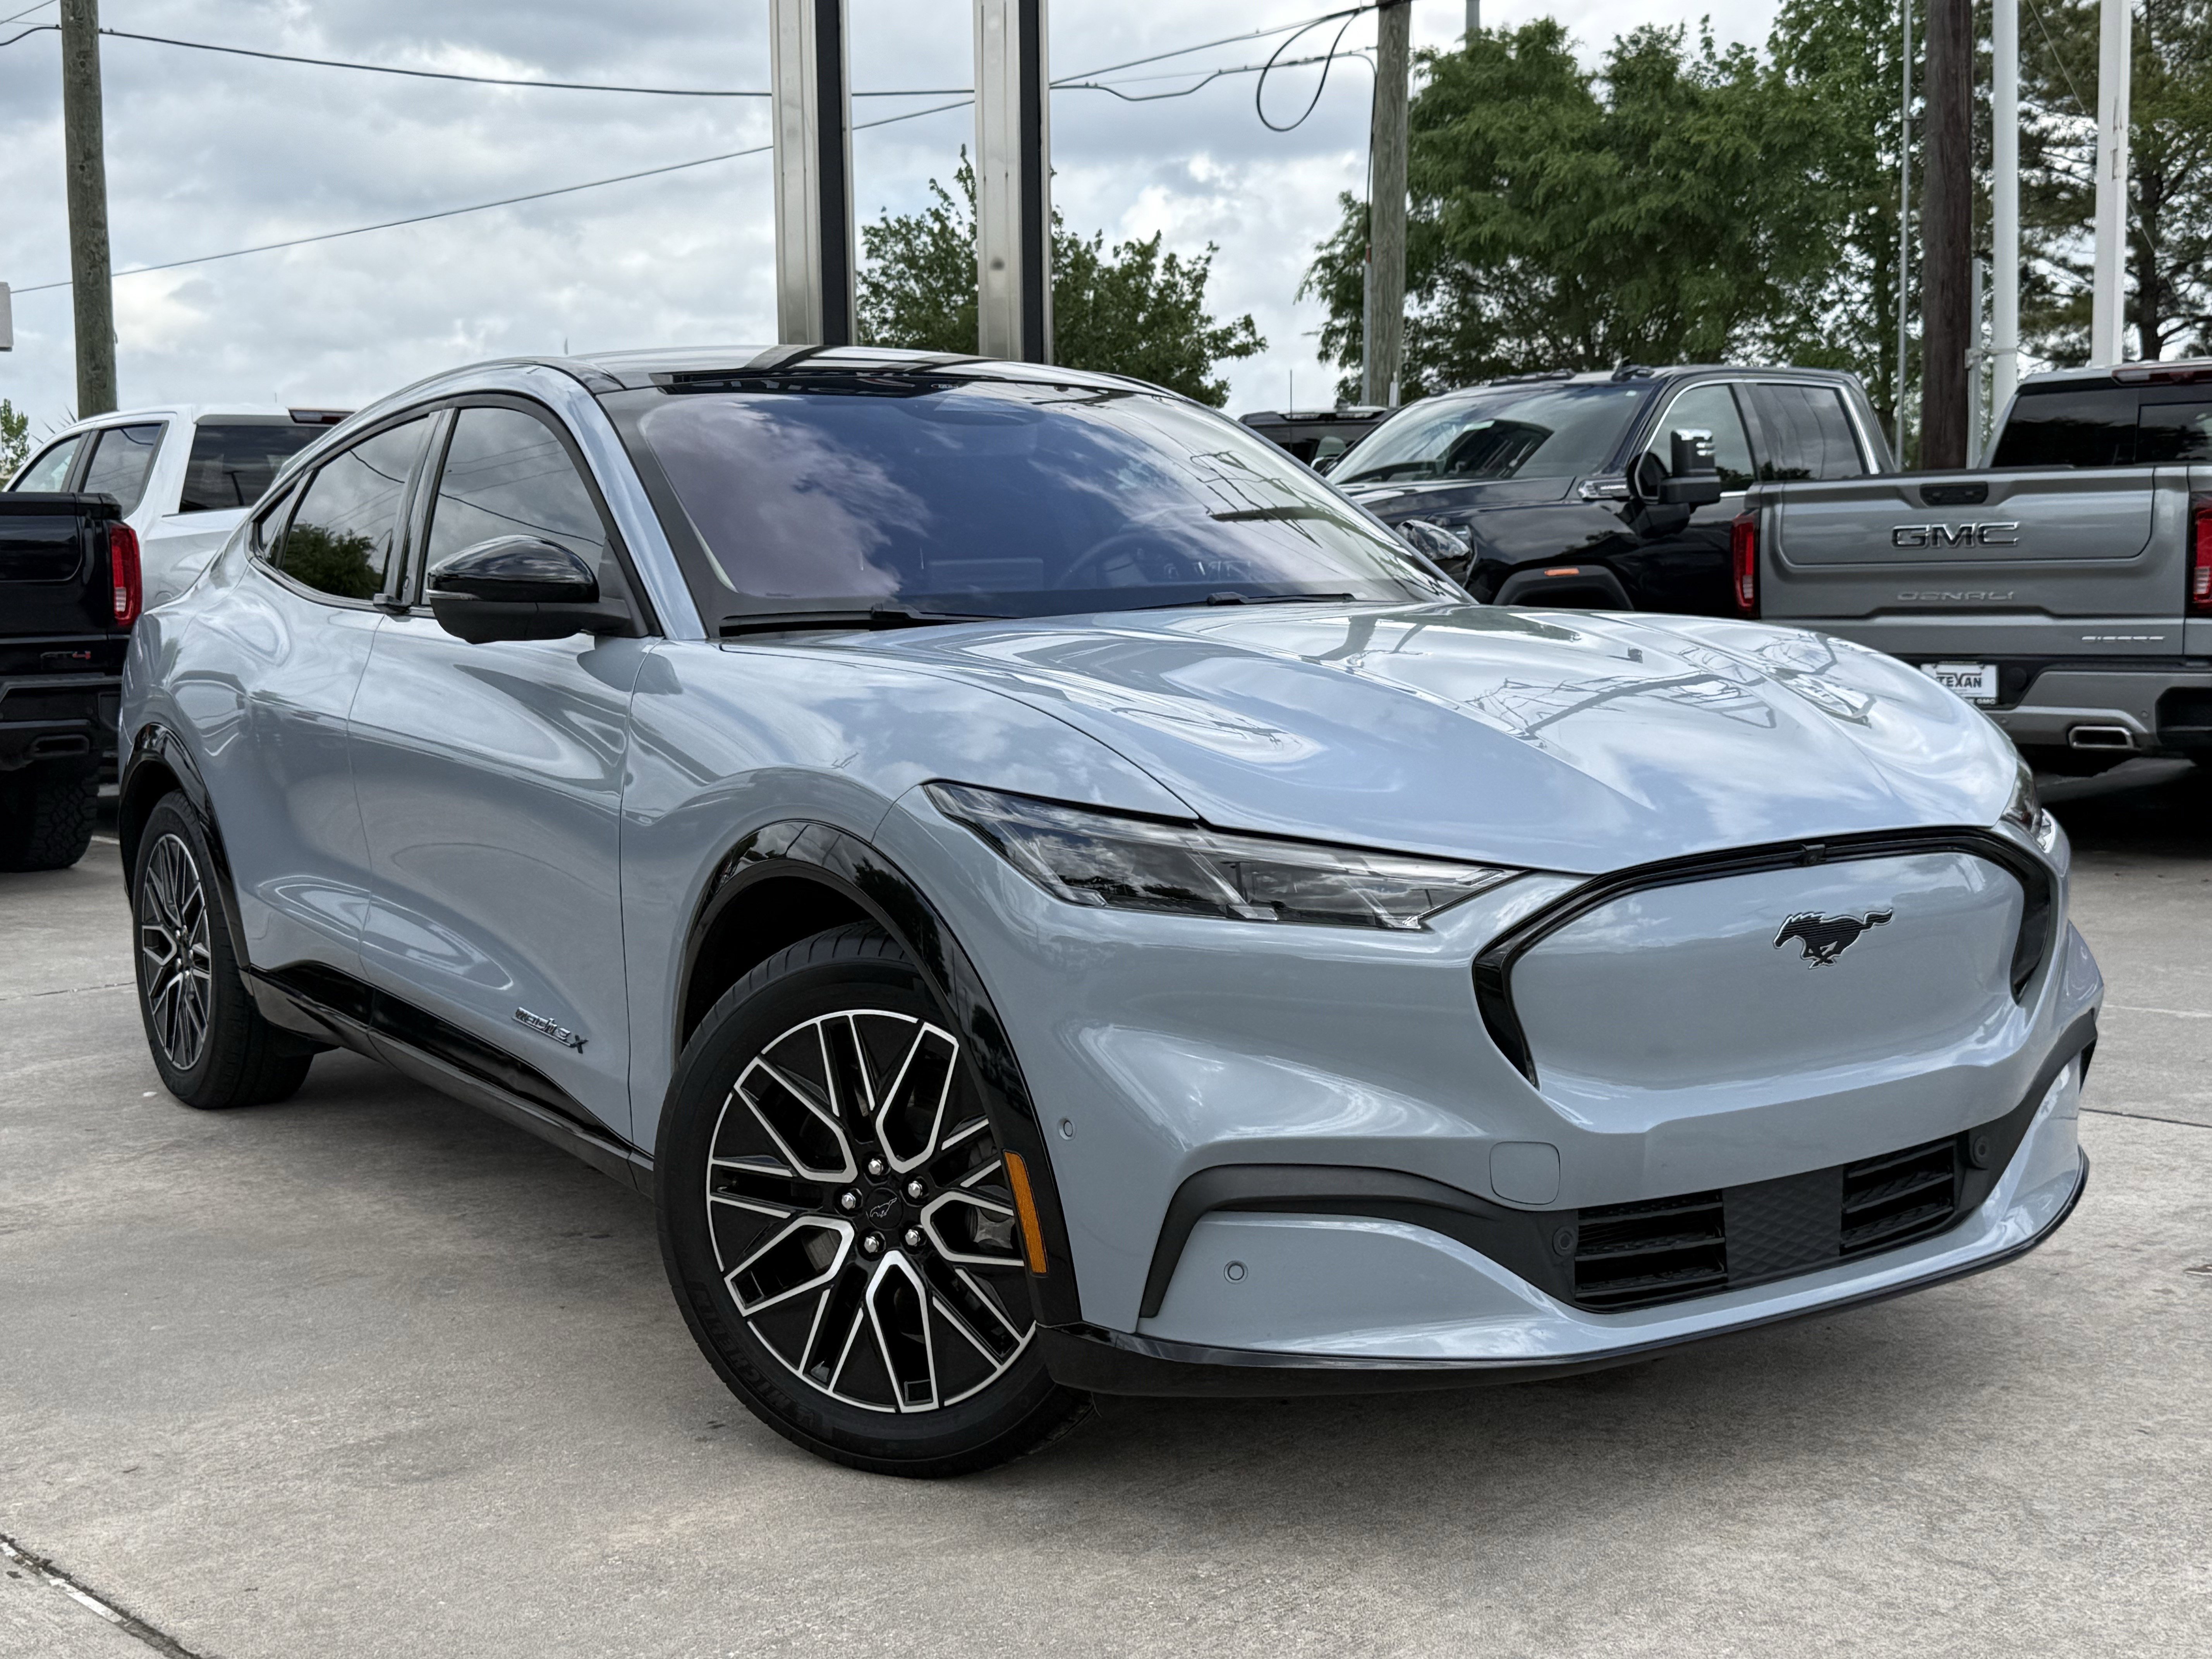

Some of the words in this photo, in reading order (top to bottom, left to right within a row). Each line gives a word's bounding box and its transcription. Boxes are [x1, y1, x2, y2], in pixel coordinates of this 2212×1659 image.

[1892, 521, 2020, 549] GMC
[1898, 591, 2013, 601] DENALI
[1936, 672, 1982, 688] TEXAN
